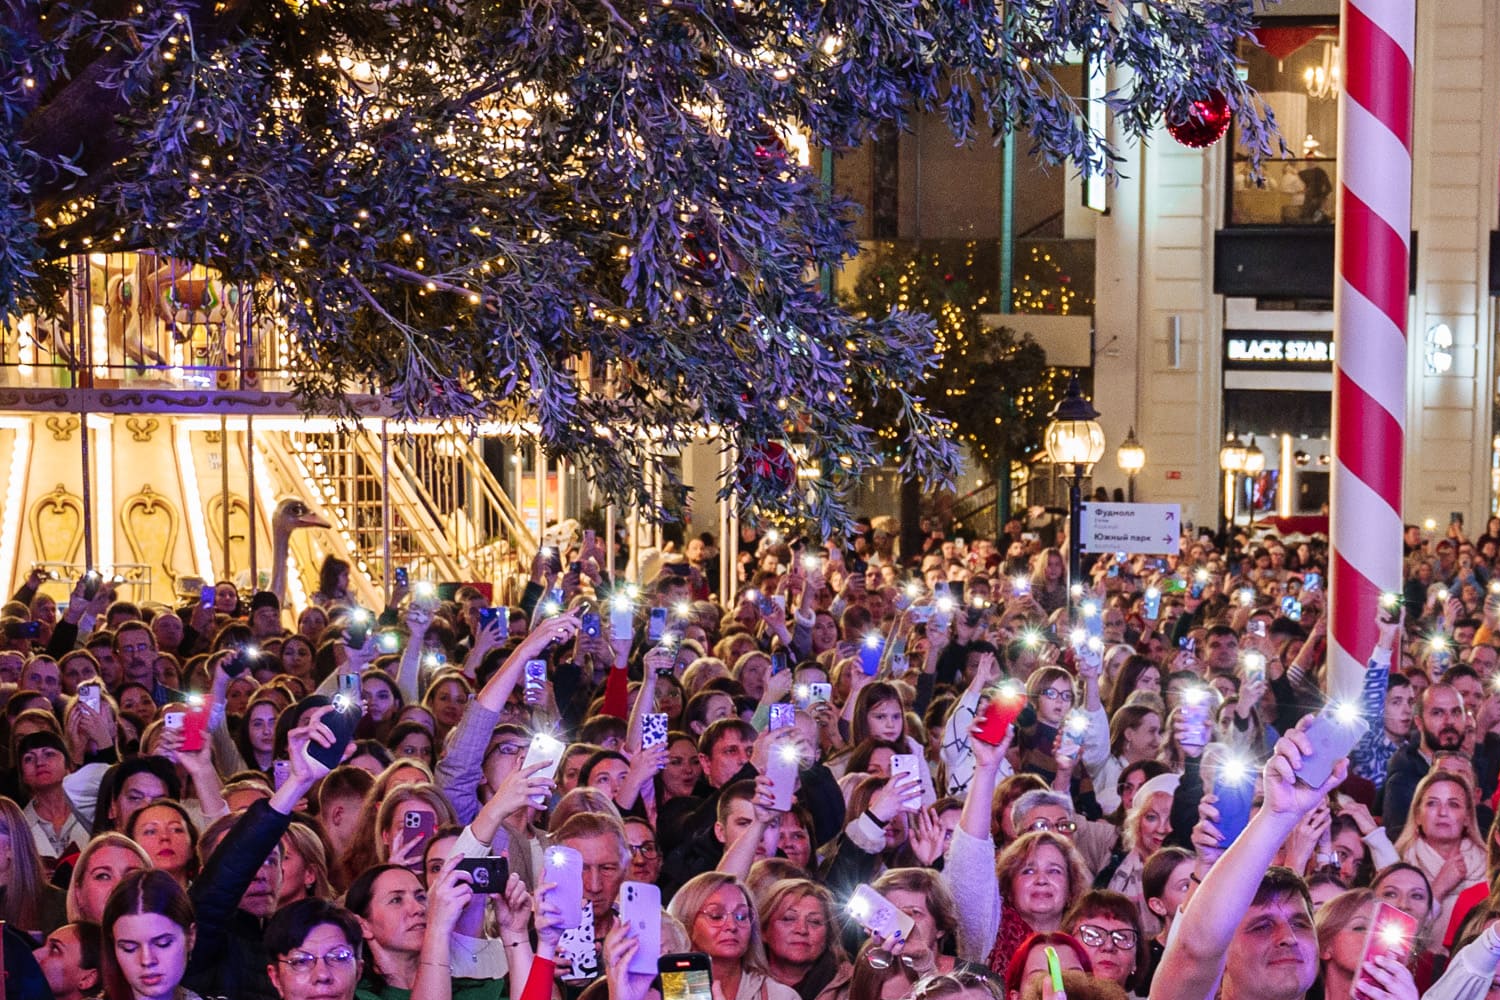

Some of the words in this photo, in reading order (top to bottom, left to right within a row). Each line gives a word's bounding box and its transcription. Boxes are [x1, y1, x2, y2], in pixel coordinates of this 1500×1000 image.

[1228, 339, 1283, 360] BLACK
[1285, 340, 1328, 361] STAR
[1094, 533, 1128, 541] Южный
[1130, 535, 1151, 543] парк
